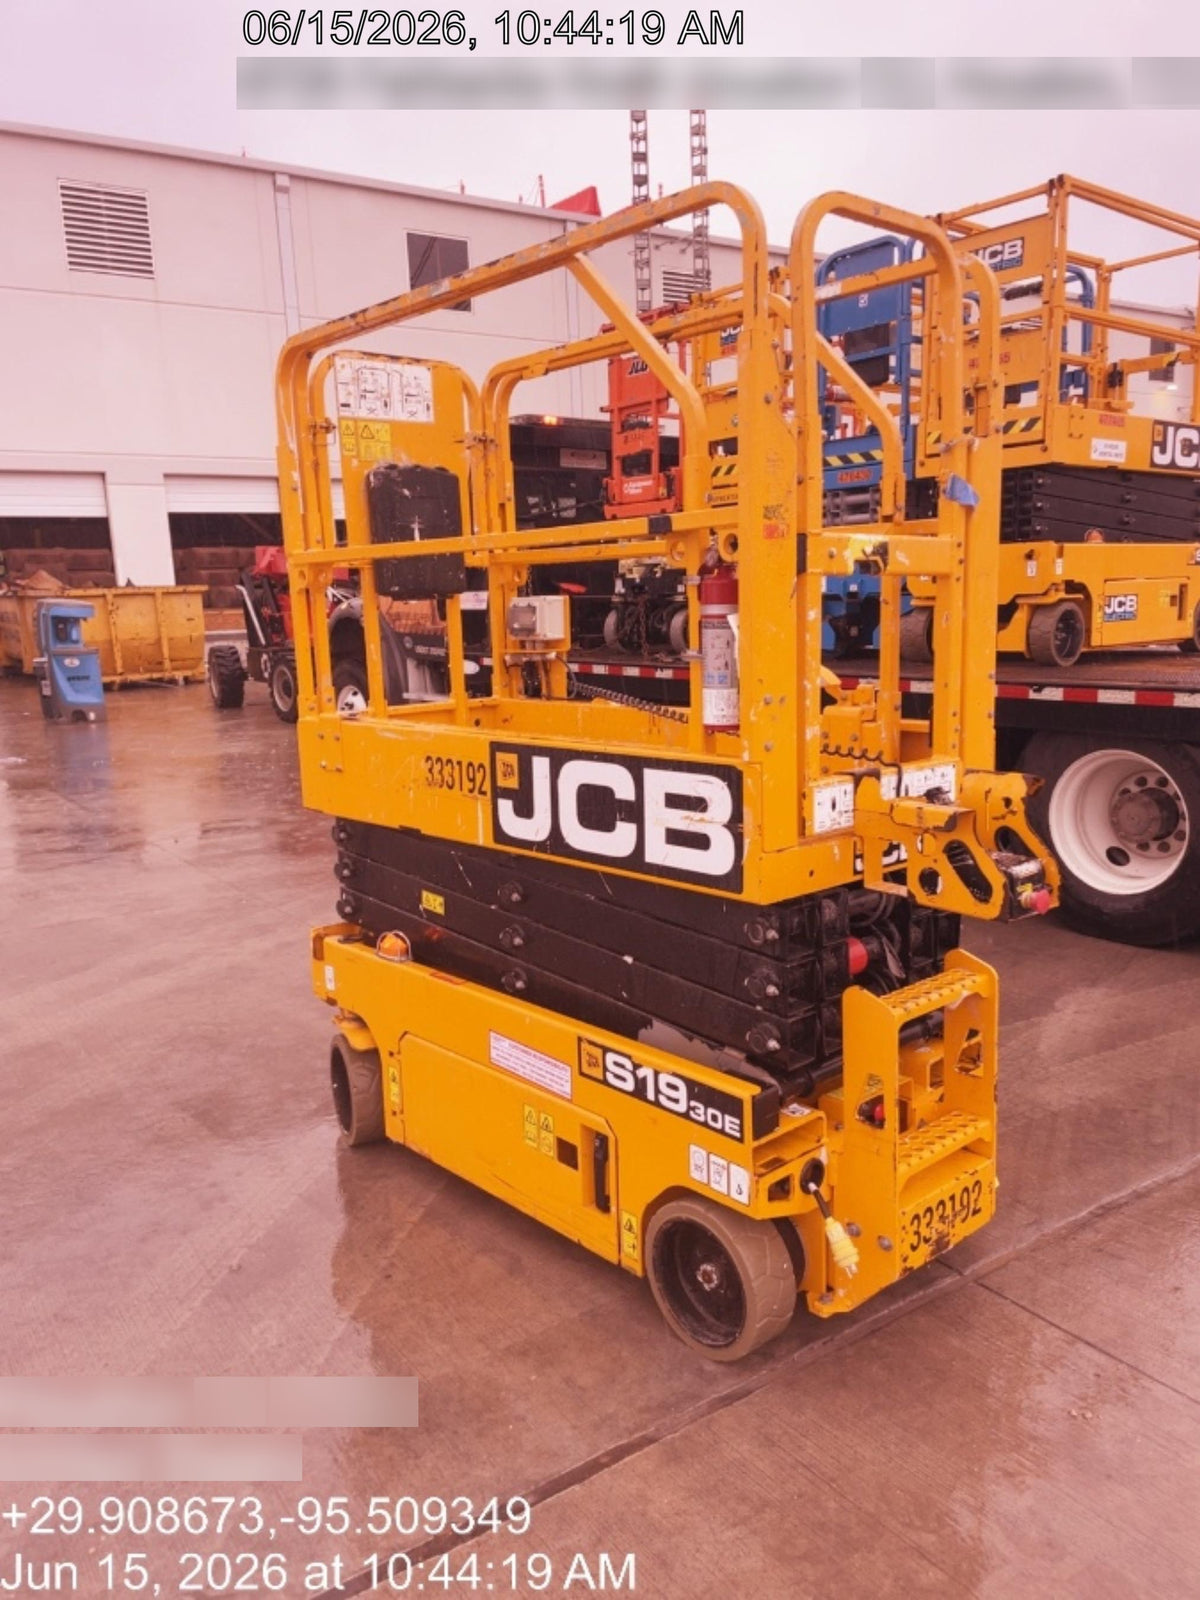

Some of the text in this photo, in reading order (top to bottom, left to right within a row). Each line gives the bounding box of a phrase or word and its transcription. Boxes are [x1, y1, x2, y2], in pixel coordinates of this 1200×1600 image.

[1152, 425, 1200, 468] JC
[1104, 594, 1138, 615] JCB
[424, 755, 488, 797] 333192
[497, 755, 737, 877] JCB
[909, 1179, 983, 1253] 333192
